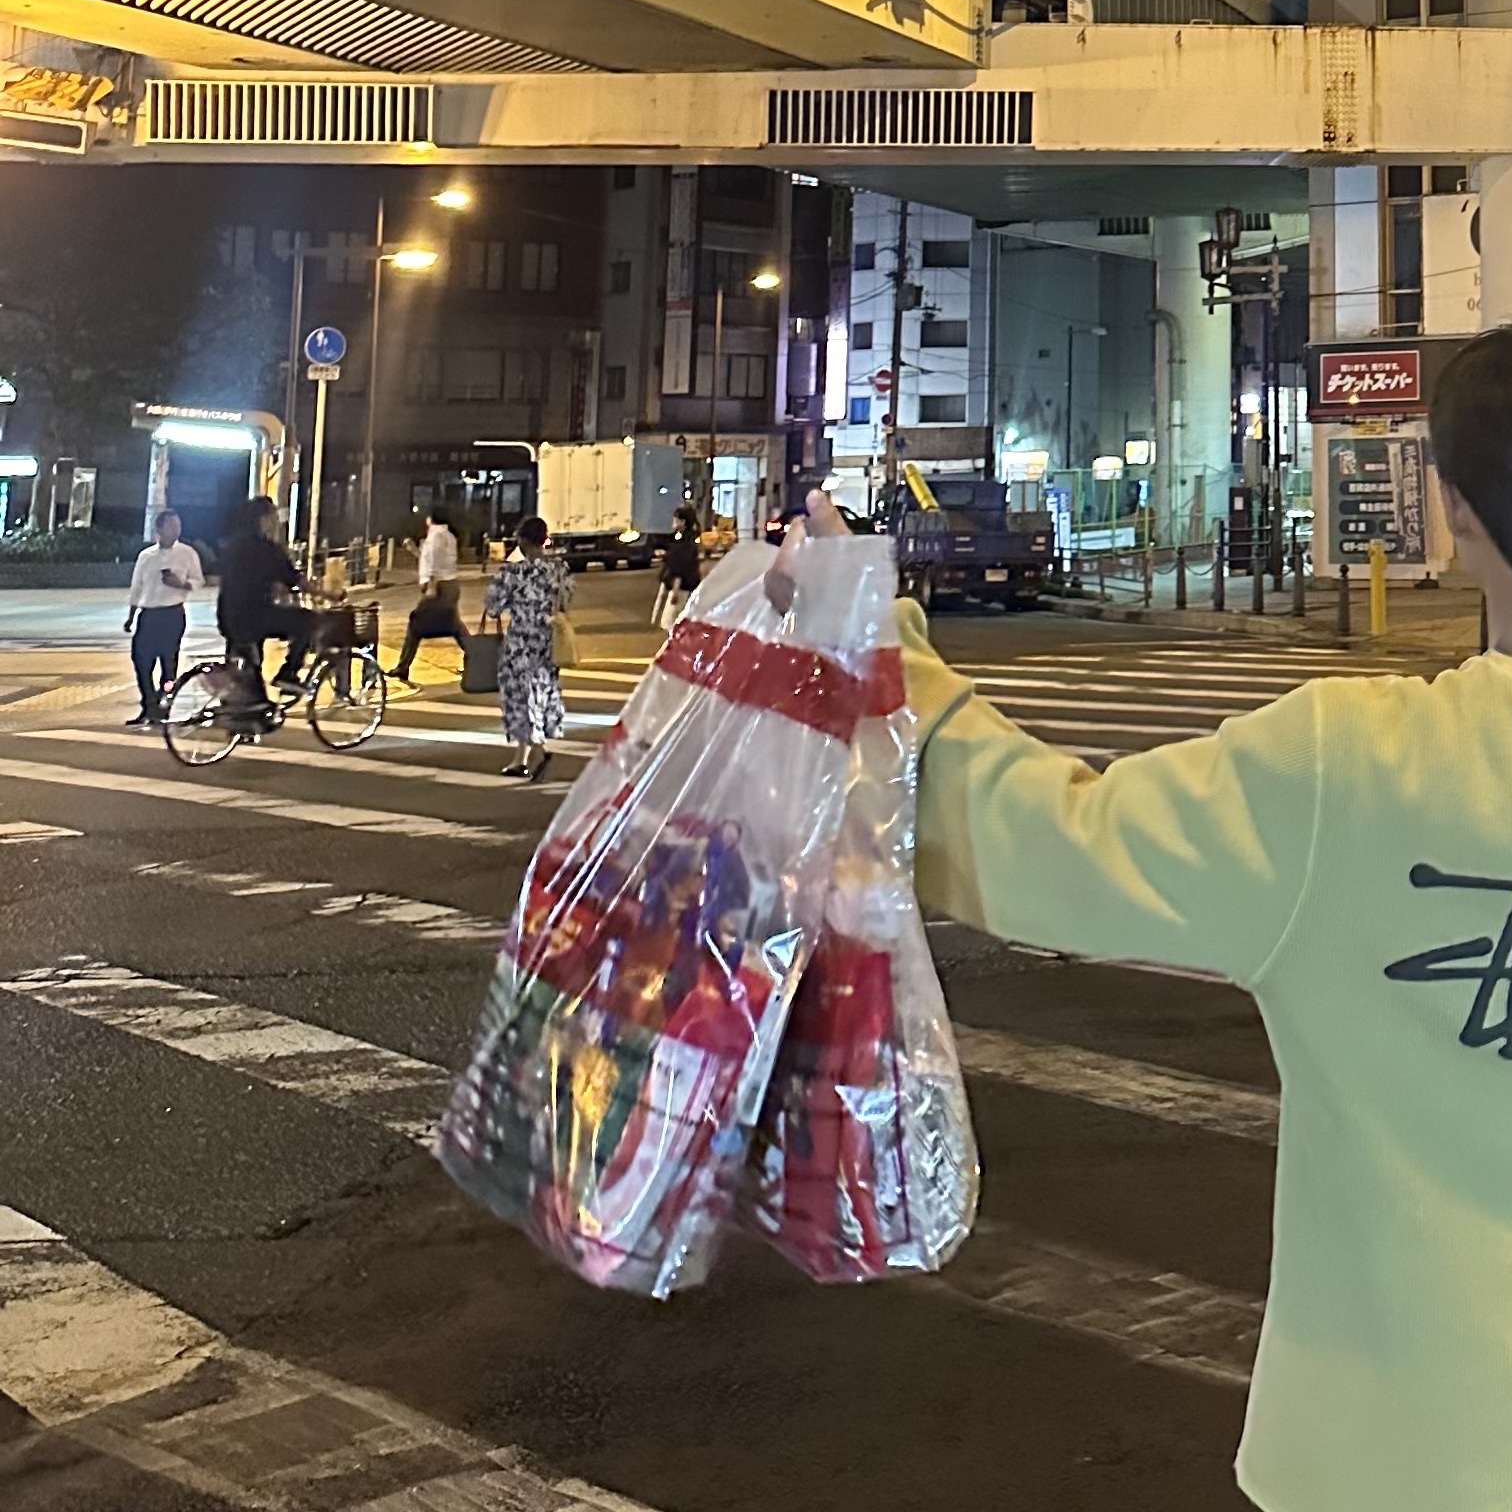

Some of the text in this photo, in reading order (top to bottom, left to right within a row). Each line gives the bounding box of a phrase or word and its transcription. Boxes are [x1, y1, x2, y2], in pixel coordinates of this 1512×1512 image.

[1327, 371, 1413, 393] チケットスーパー
